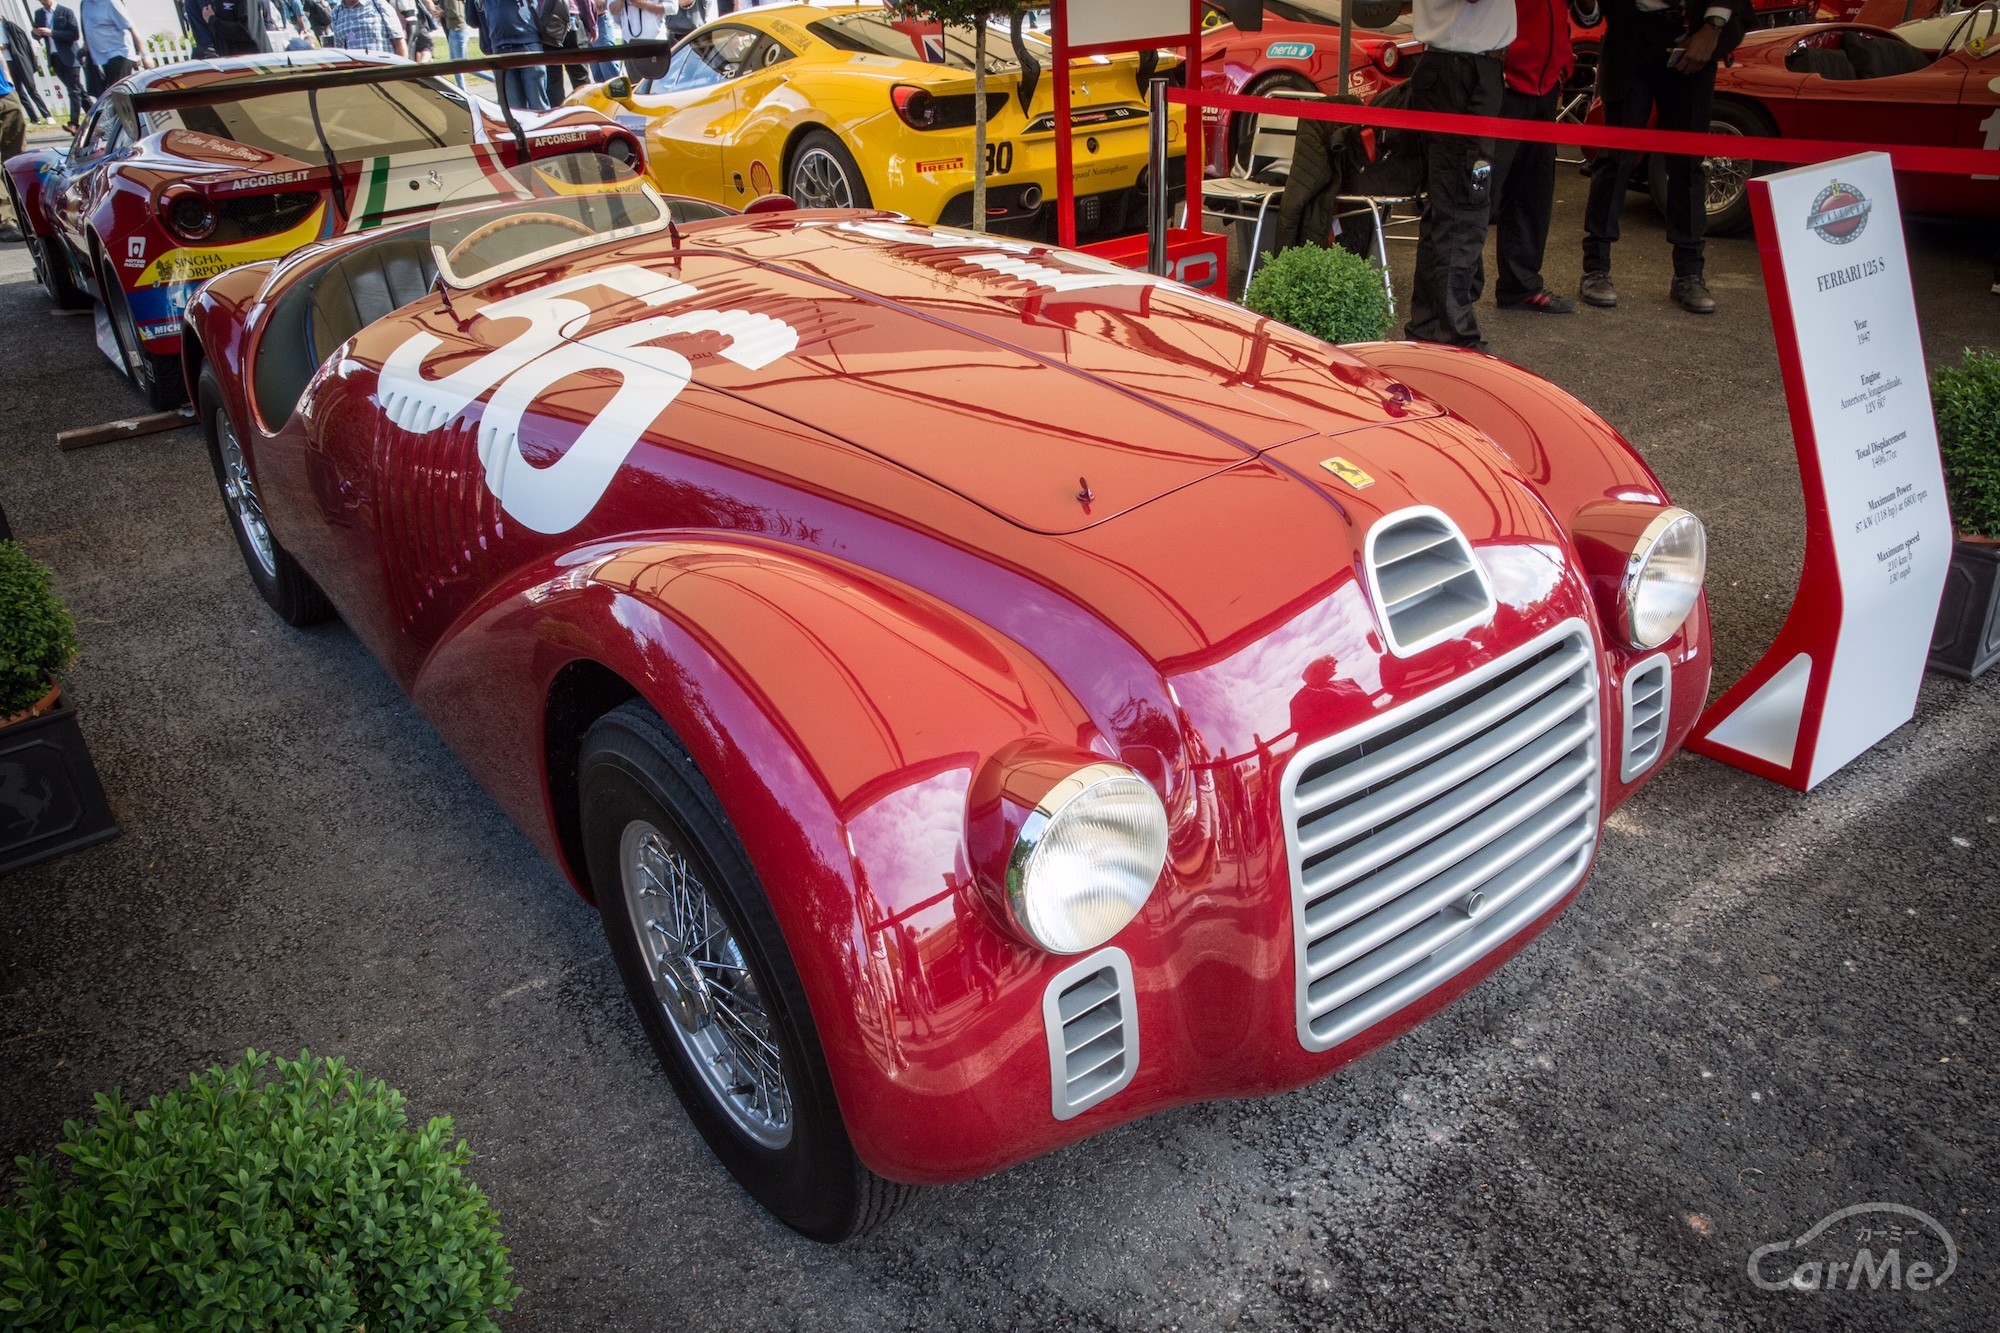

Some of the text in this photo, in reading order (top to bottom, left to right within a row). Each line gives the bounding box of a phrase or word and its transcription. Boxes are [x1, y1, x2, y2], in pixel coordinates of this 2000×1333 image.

[1270, 44, 1297, 56] nerta
[1115, 109, 1129, 117] EU
[535, 132, 587, 147] AFCORSE.IT
[916, 157, 963, 174] PIRELLI
[232, 171, 310, 191] AFCORSE.IT
[174, 254, 222, 268] SINGHA
[1817, 256, 1886, 292] FERRARI 125 S
[1854, 320, 1867, 331] Year
[1858, 331, 1871, 345] 1947
[1860, 371, 1881, 386] Engine
[377, 264, 800, 534] 56
[1841, 376, 1903, 410] Anteriore, longitudinale,
[1865, 400, 1876, 415] 12V
[1855, 430, 1907, 460] Total Displacement
[1868, 483, 1912, 511] Maximum Power
[1855, 521, 1862, 534] 87
[1863, 515, 1873, 530] kW
[1874, 508, 1887, 526] (118
[1887, 503, 1898, 519] hp)
[1904, 493, 1916, 508] 6800
[1917, 490, 1928, 504] rpm
[1877, 531, 1920, 563] Maximum speed
[1888, 558, 1898, 573] 210
[1890, 565, 1911, 585] 130 mph
